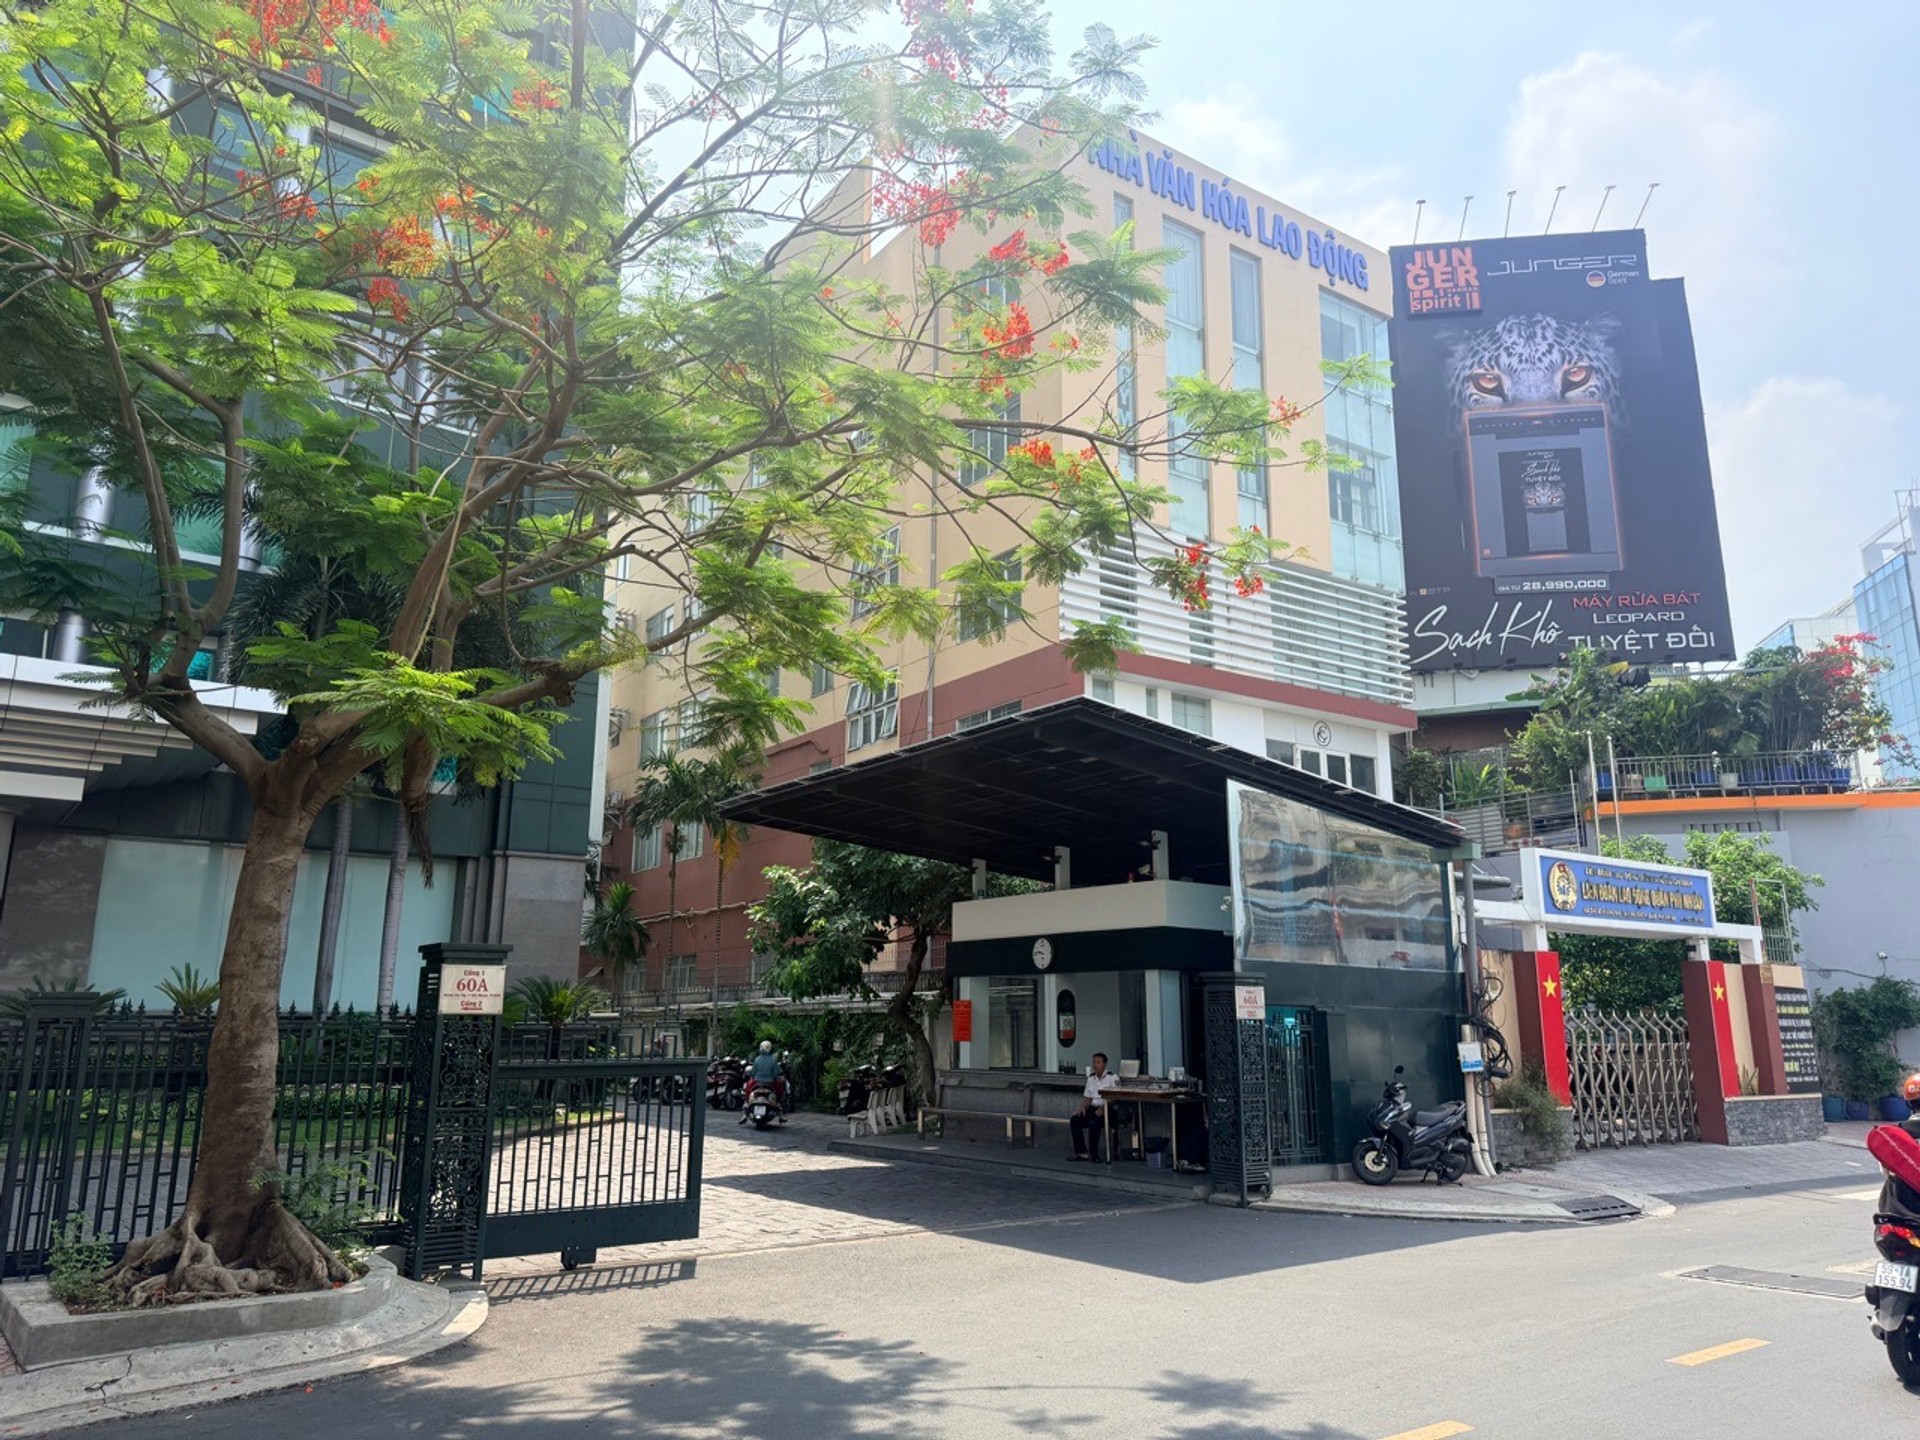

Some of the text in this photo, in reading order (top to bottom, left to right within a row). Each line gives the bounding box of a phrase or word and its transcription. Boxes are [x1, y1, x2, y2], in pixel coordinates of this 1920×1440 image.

[1088, 128, 1369, 291] NHÀ VĂN HÓA LAO ĐỘNG
[1487, 254, 1637, 276] JUNGER
[1410, 294, 1461, 313] spirit
[1572, 590, 1701, 609] MÁY RỬA BÁT
[1593, 611, 1685, 624] LEOPARD
[1408, 599, 1564, 664] Sạch Khô
[1567, 624, 1716, 654] TUYỆT ĐỐI
[456, 978, 489, 992] 60A
